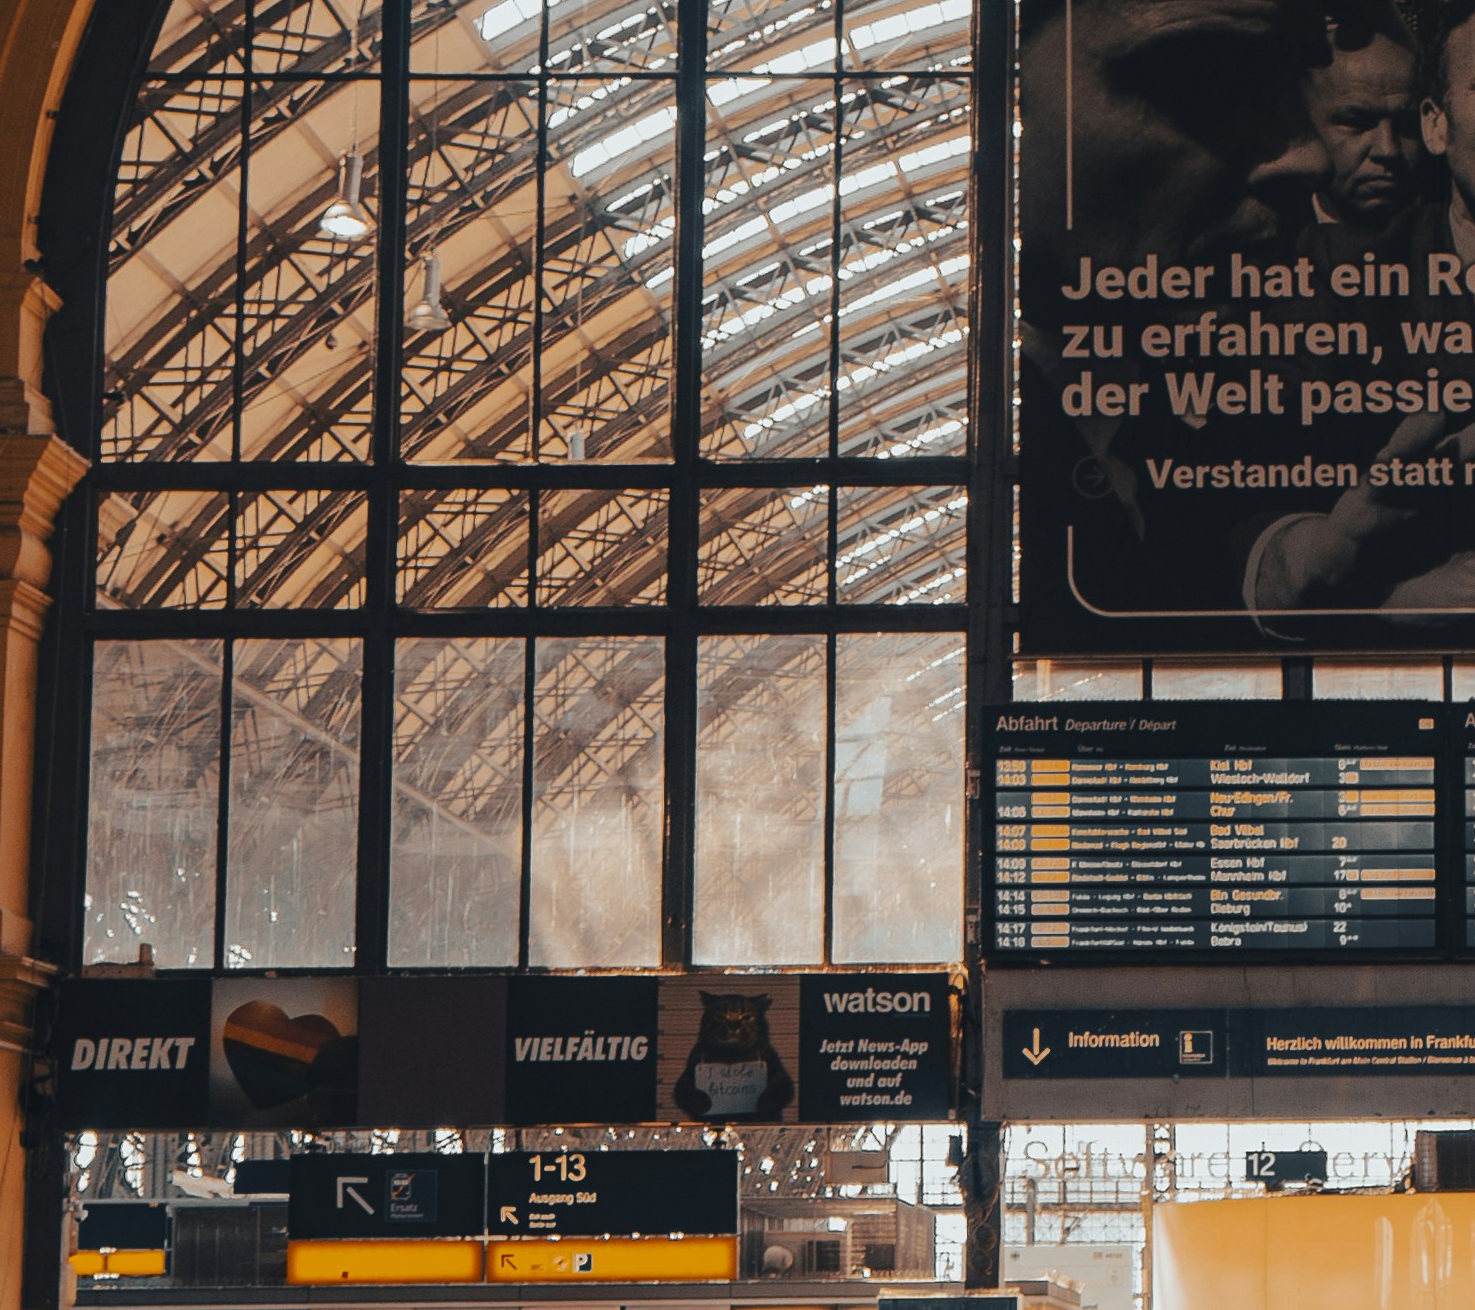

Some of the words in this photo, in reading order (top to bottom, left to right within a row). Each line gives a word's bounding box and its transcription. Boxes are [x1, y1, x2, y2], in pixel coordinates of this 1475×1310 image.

[1062, 255, 1213, 301] Jeder
[1231, 255, 1314, 299] hat
[1331, 254, 1410, 297] ein
[1062, 326, 1123, 359] zu
[1141, 311, 1383, 365] erfahren,
[1062, 373, 1149, 417] der
[1164, 371, 1285, 416] Welt
[1147, 457, 1358, 490] Verstanden
[1370, 457, 1453, 487] statt
[996, 716, 1058, 731] Abfahrt
[1065, 719, 1126, 732] Departure
[1139, 719, 1176, 732] Départ
[1234, 759, 1252, 771] Hbf
[1280, 838, 1299, 849] Hbf
[1211, 857, 1242, 868] Essen
[1246, 857, 1265, 868] Hbf
[997, 871, 1026, 882] 14:12
[1211, 871, 1264, 882] Mannheim
[1268, 870, 1286, 882] Hbf
[997, 890, 1025, 901] 14:14
[997, 903, 1025, 915] 14:15
[997, 922, 1025, 934] 14:17
[1333, 921, 1346, 932] 22
[823, 988, 931, 1013] watson
[514, 1030, 648, 1066] VIELFÄLTIG
[820, 1039, 854, 1053] Jetzt
[858, 1039, 928, 1055] News-App
[1069, 1031, 1160, 1049] Information
[1266, 1036, 1322, 1052] Herzlich
[1325, 1035, 1407, 1050] willkommen
[1410, 1035, 1423, 1049] in
[70, 1037, 195, 1071] DIREKT
[831, 1055, 917, 1070] downloaden
[846, 1073, 875, 1088] und
[877, 1073, 903, 1088] auf
[840, 1090, 913, 1105] watson.de
[529, 1154, 587, 1182] 1-13
[1248, 1153, 1276, 1177] 12
[529, 1191, 574, 1207] Ausgang
